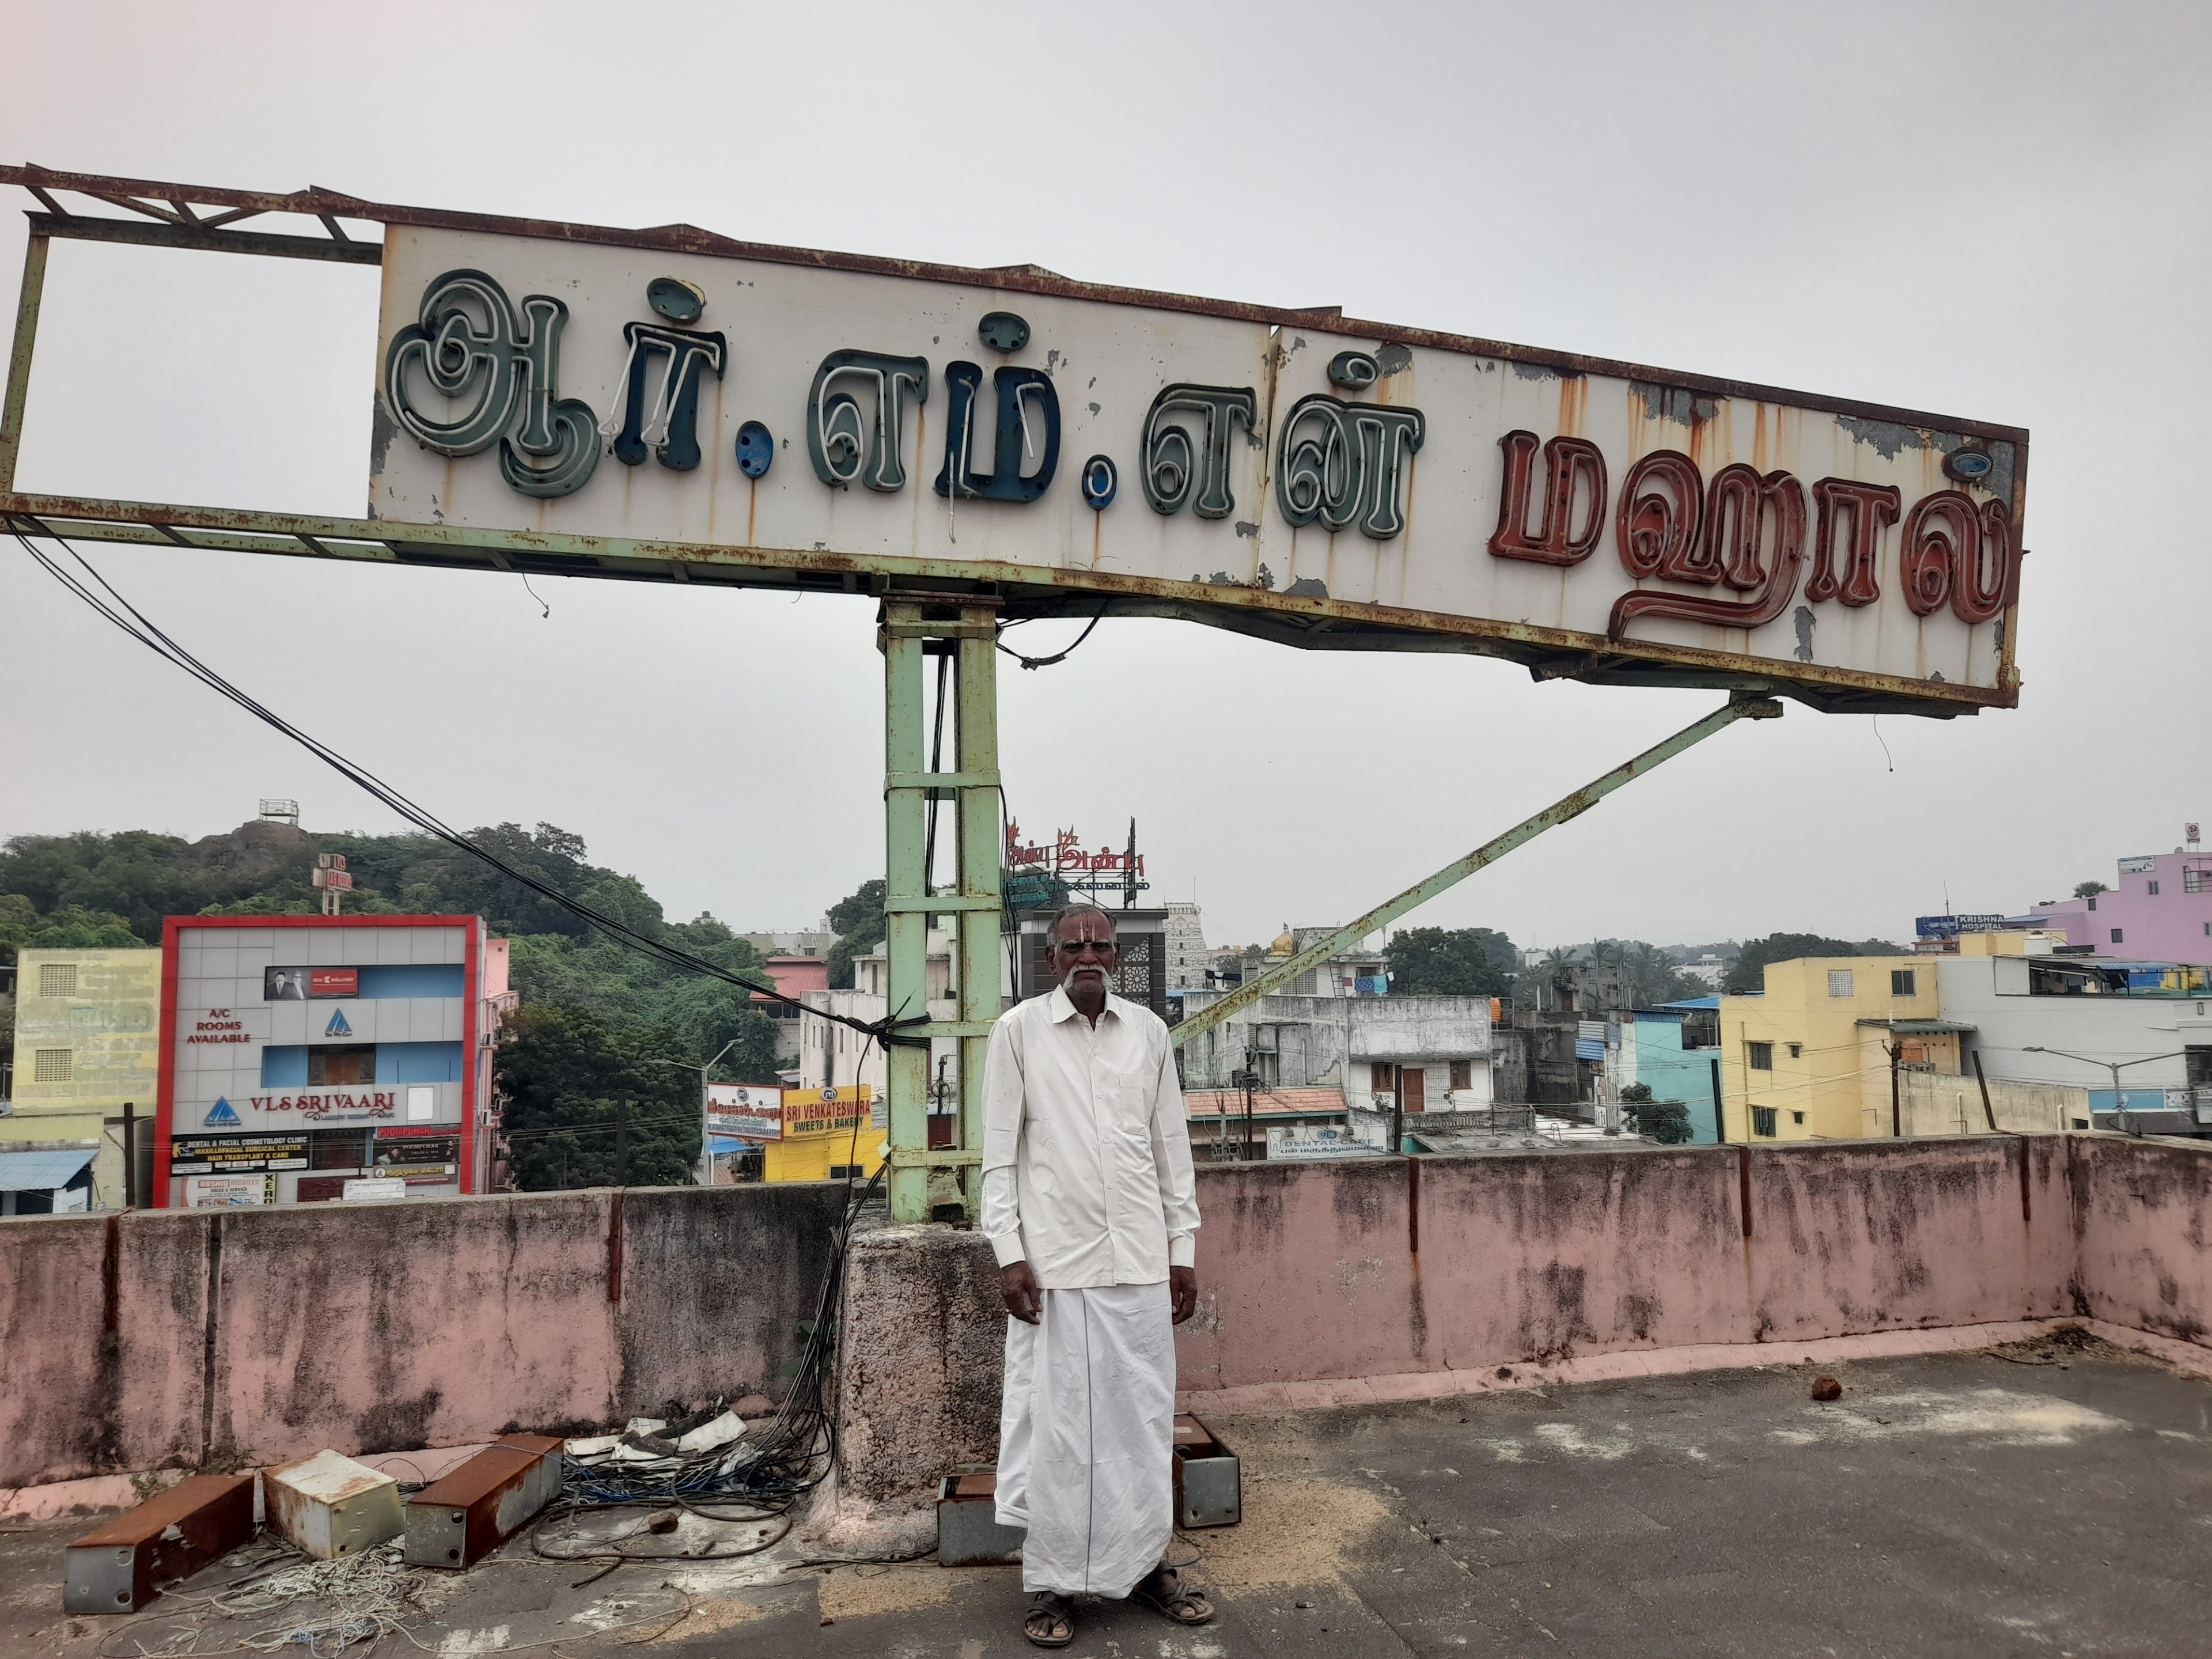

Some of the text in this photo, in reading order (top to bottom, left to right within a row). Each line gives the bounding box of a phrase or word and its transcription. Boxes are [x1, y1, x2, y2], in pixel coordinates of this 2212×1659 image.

[1488, 430, 2010, 642] மஹால்
[1009, 840, 1050, 868] அன்பு
[1058, 846, 1145, 877] அன்பு
[210, 1009, 230, 1018] A/C
[196, 1021, 241, 1031] ROOMS
[187, 1034, 251, 1044] AVAILABLE
[249, 1097, 291, 1111] VLS
[786, 1105, 801, 1122] SRI
[804, 1099, 870, 1119] VENKATESWARA
[794, 1116, 863, 1132] SWEETS & BAKERY
[378, 1127, 430, 1136] POOMPUHAR
[241, 1138, 286, 1146] COSMETOLOGY
[1300, 1144, 1385, 1153] மருத்துவமனை
[386, 1165, 445, 1177] ஆறுமுகம் ஸ்டோர்
